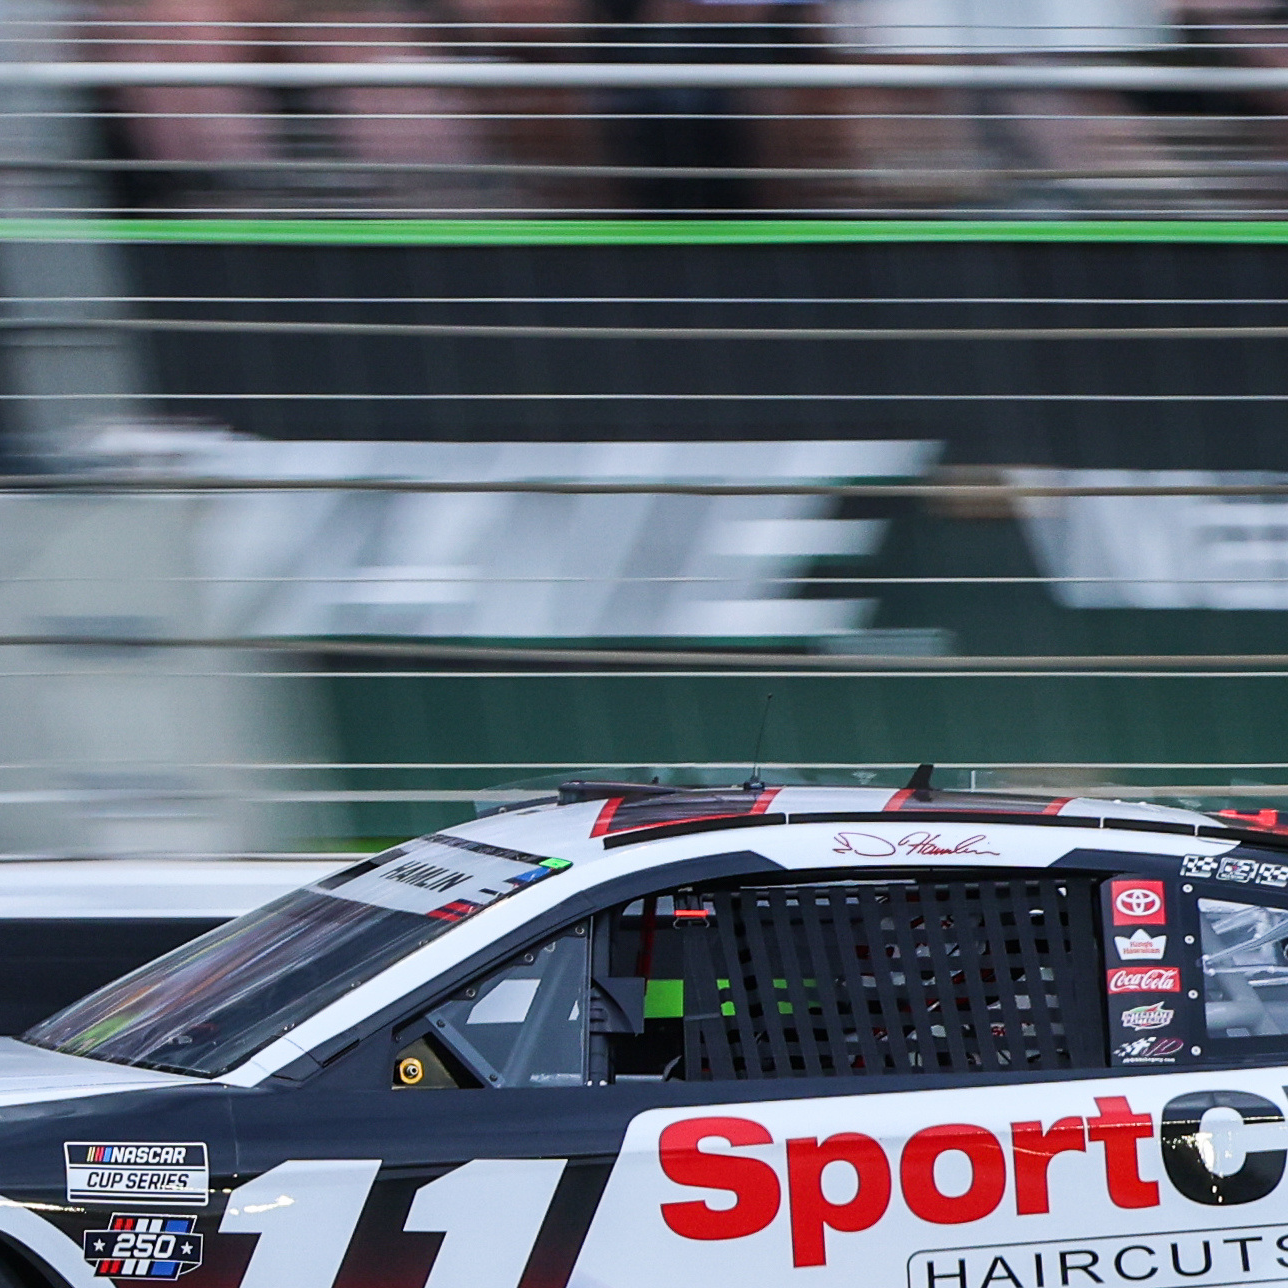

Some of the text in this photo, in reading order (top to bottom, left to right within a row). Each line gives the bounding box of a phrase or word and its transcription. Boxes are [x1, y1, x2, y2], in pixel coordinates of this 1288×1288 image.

[380, 860, 473, 893] HAMLIN
[1110, 969, 1178, 991] Coca-Cola
[112, 1146, 186, 1165] NASCAR
[86, 1171, 188, 1191] CUP SERIES
[112, 1233, 175, 1259] 250
